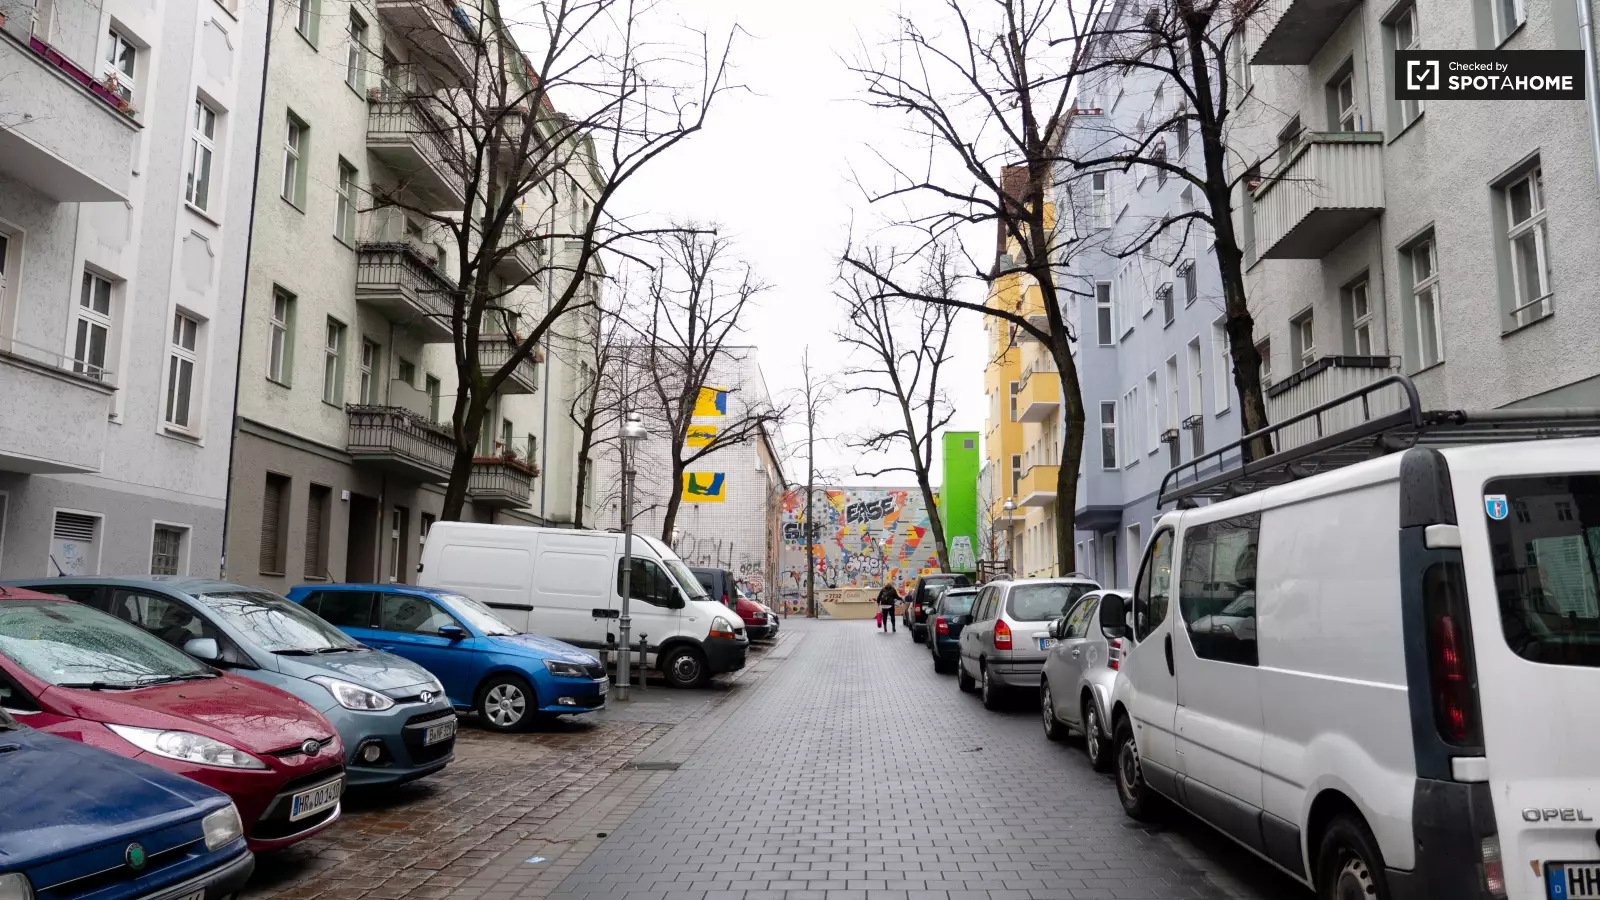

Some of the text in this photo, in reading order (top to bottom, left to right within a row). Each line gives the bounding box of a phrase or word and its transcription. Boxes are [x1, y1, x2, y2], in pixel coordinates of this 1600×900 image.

[845, 494, 897, 524] EASE
[298, 794, 310, 813] HR
[1521, 808, 1594, 822] OPEL
